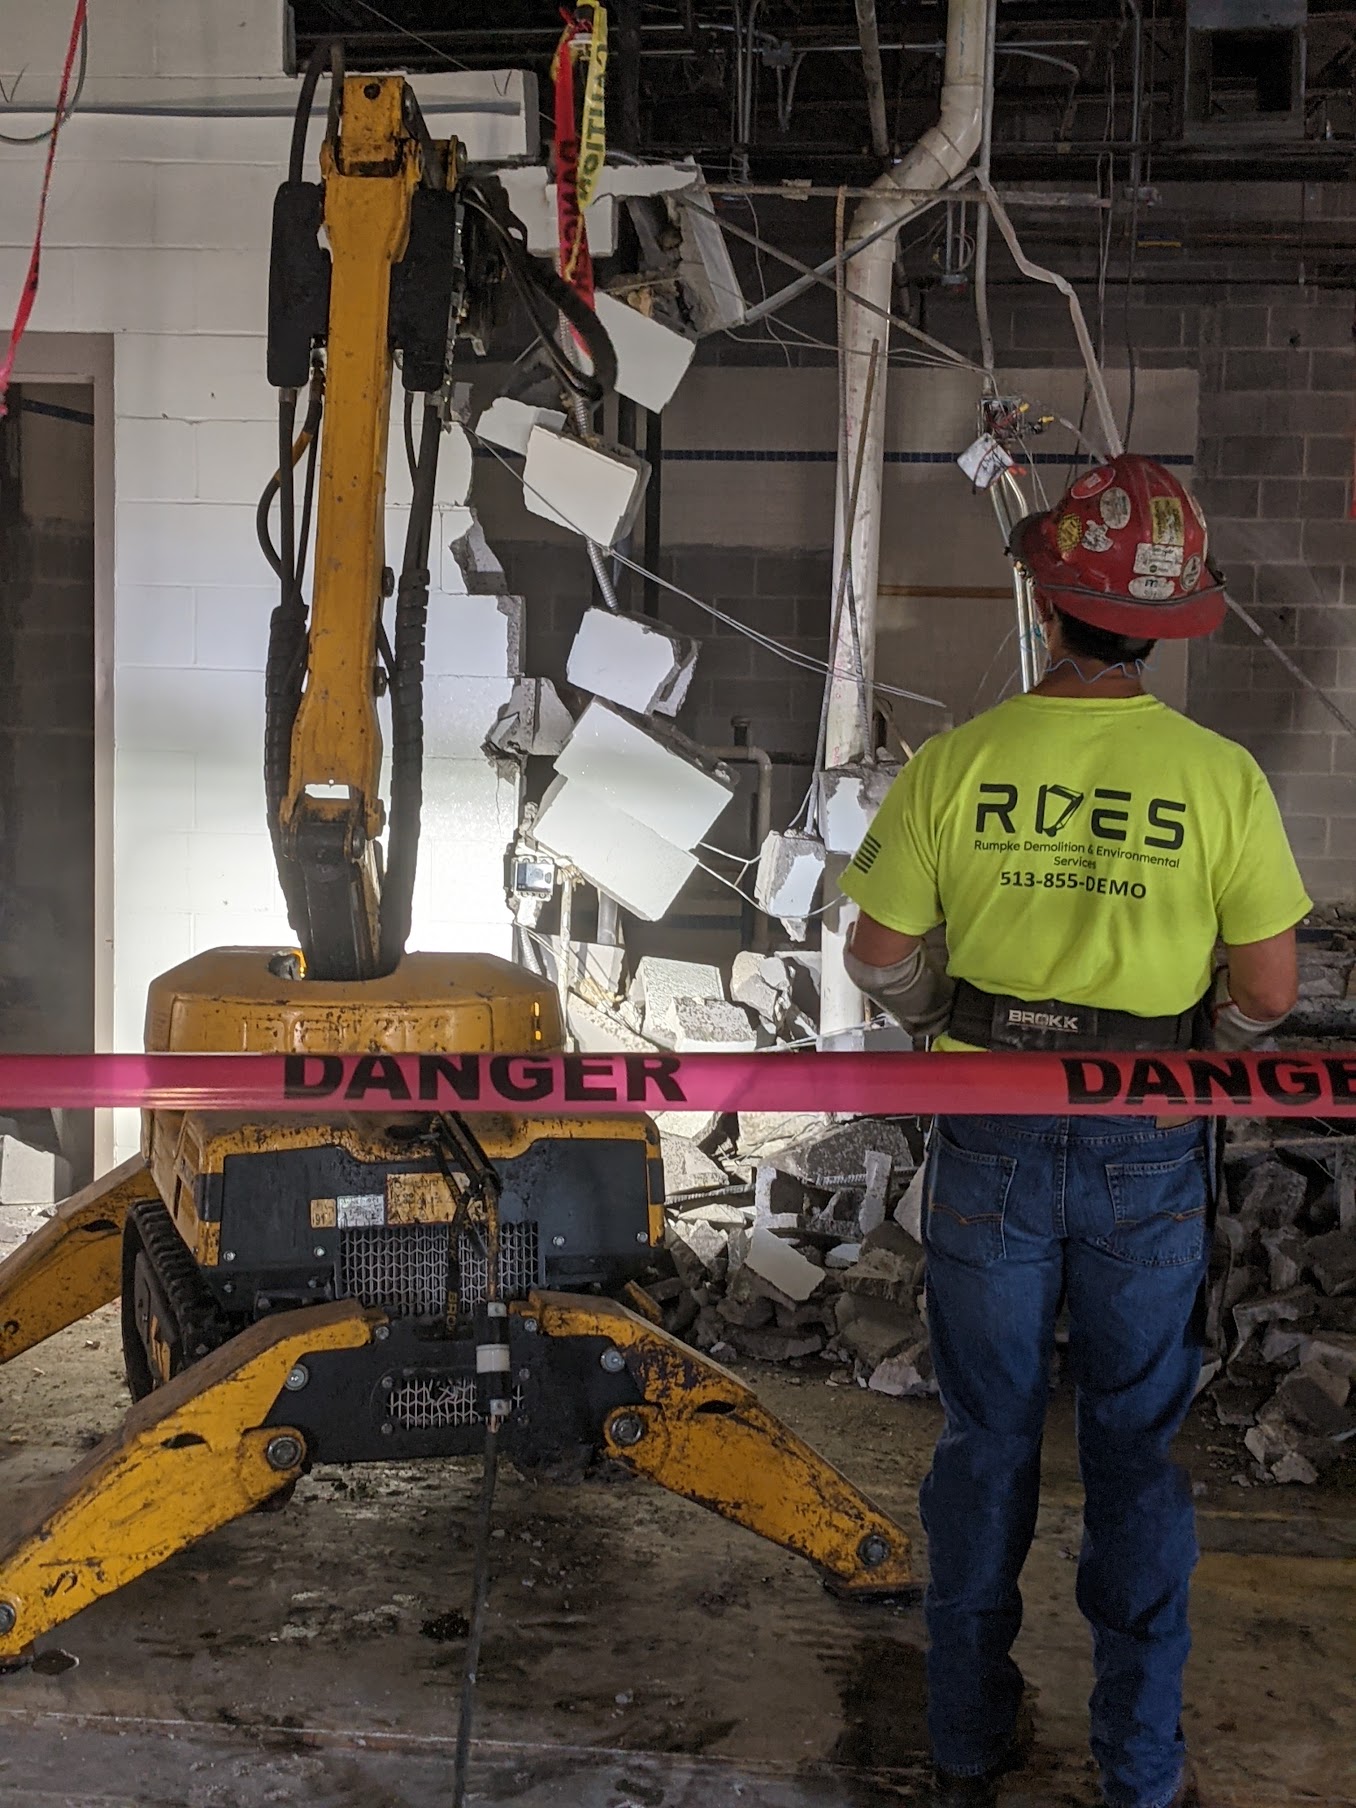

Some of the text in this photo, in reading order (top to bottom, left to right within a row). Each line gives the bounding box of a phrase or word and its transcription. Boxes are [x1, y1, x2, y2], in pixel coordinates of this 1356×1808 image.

[974, 840, 1020, 853] Rumpke
[1023, 840, 1085, 853] Demolition
[1096, 846, 1180, 868] Environmental
[1053, 856, 1097, 869] Services
[1000, 871, 1147, 899] 513-855-DEMO
[1008, 1009, 1079, 1029] BROKK
[283, 1054, 688, 1101] DANGER
